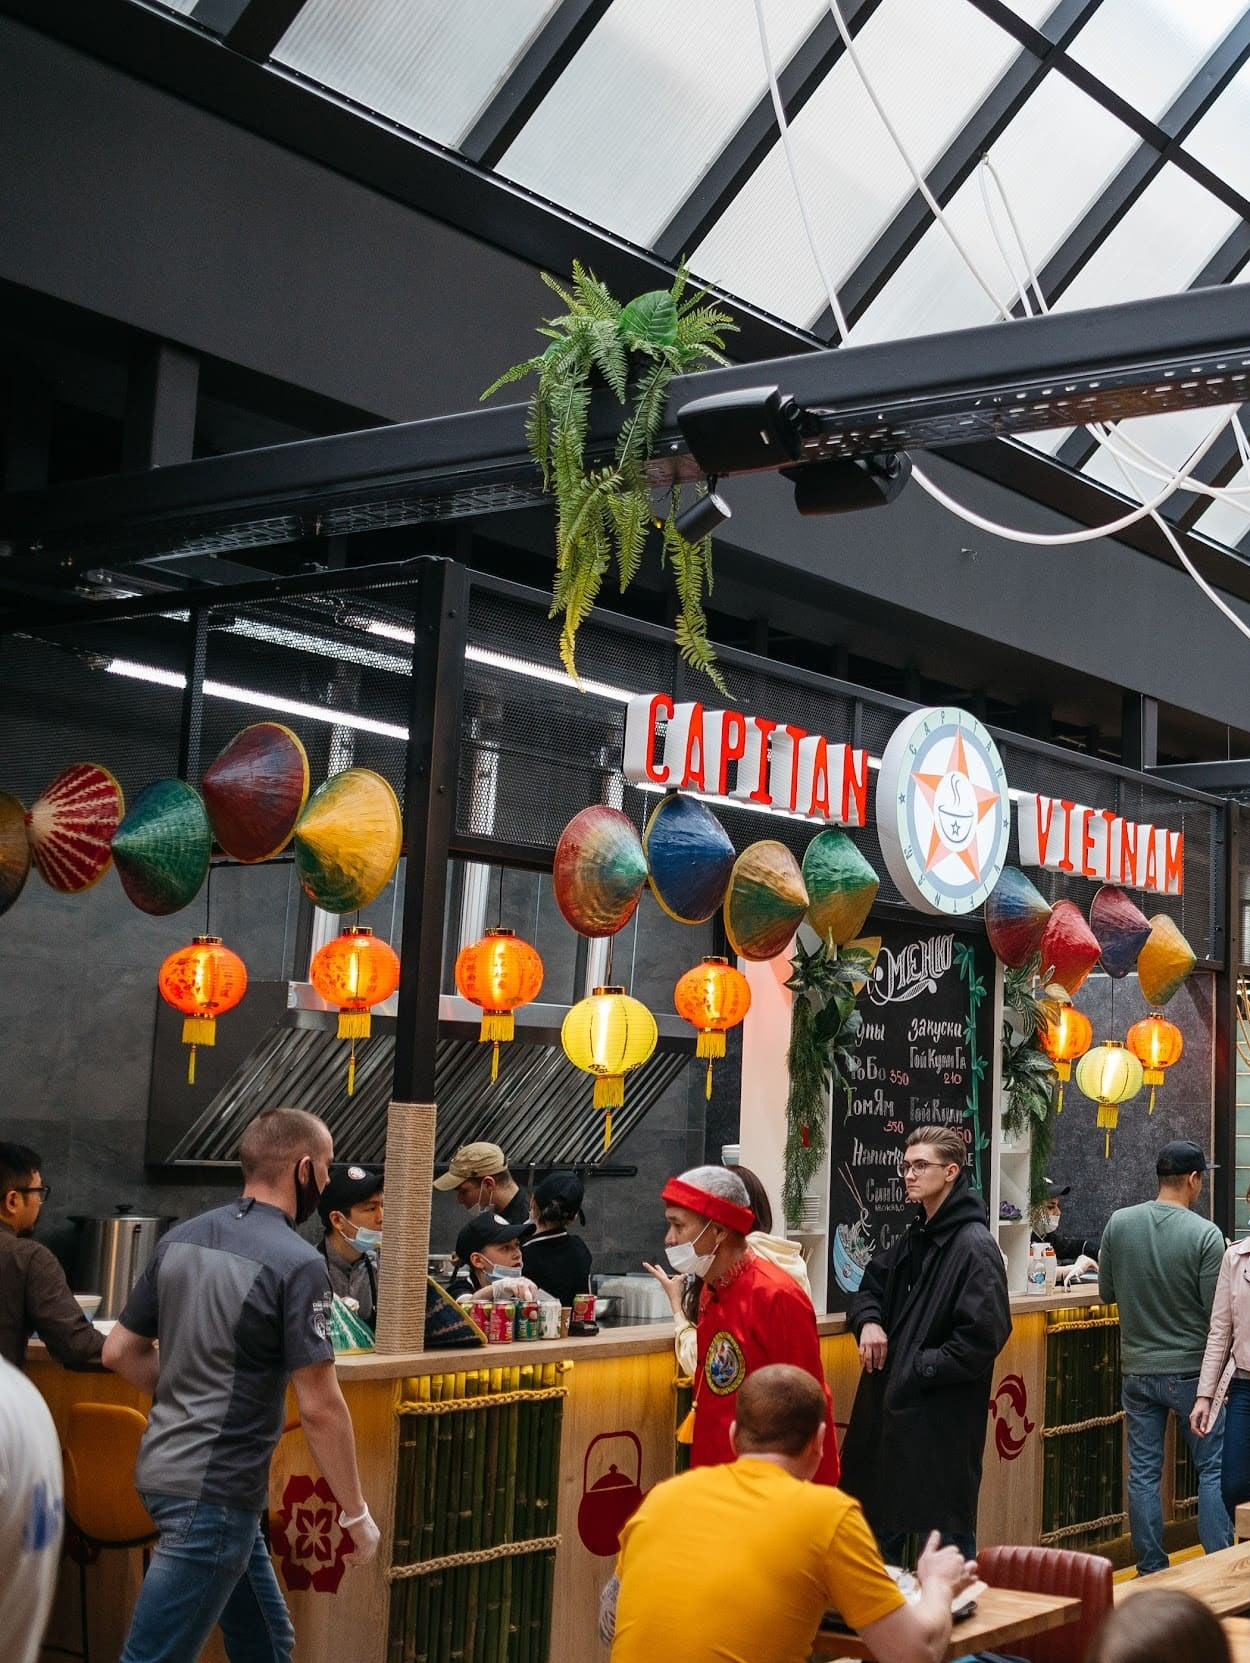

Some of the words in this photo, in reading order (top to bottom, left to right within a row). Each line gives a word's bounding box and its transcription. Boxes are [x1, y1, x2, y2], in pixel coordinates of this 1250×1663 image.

[642, 693, 869, 828] CAPITAN
[1030, 791, 1185, 896] VIETNAM
[855, 1022, 885, 1047] упы
[889, 1068, 910, 1086] 350
[943, 1071, 963, 1085] 210
[883, 1121, 905, 1134] 350
